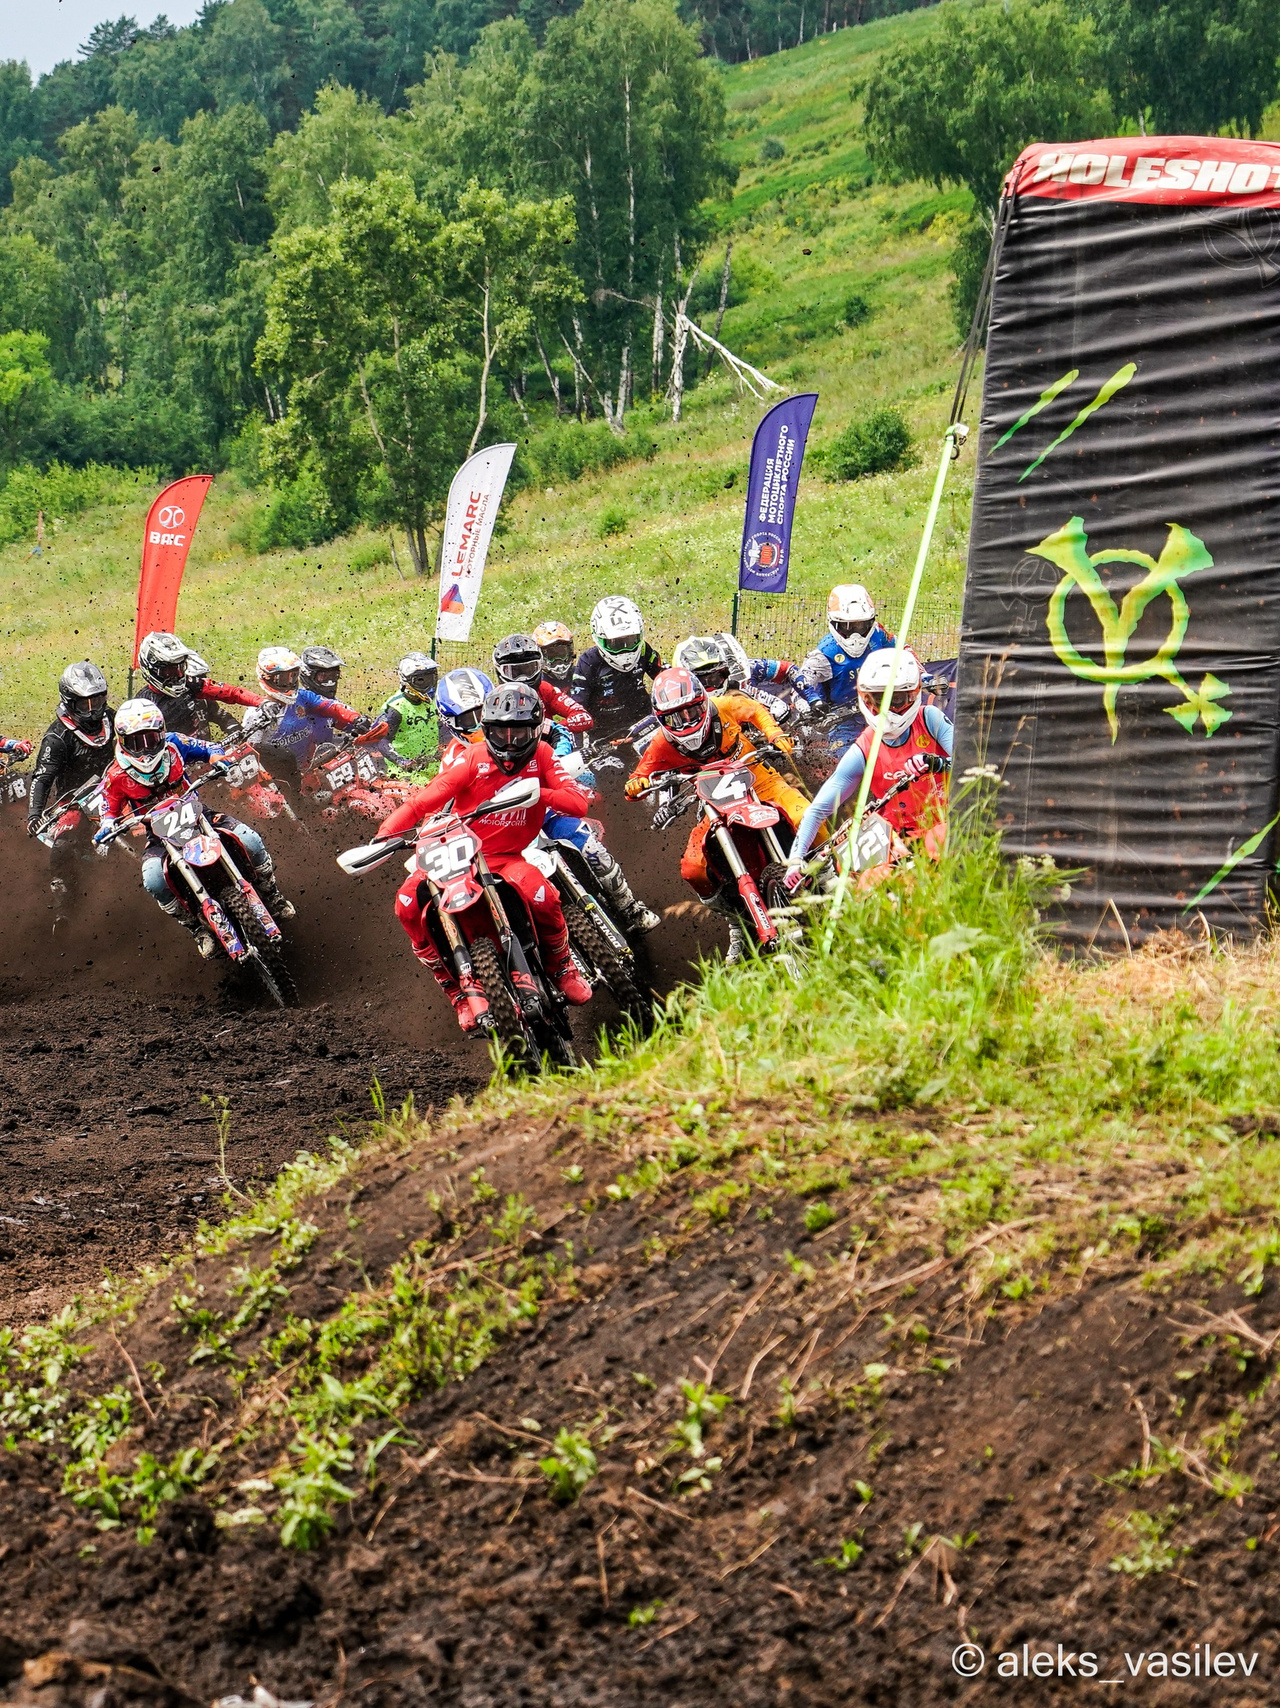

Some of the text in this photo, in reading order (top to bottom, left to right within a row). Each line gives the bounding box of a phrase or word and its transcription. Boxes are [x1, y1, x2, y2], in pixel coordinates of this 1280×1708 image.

[1033, 153, 1280, 194] HOLESHO
[758, 458, 775, 522] ФЕДЕРАЦИЯ
[767, 424, 789, 523] МОТОЦИКЛЕТНОГО
[776, 438, 795, 525] СПОРТА РОССИИ
[475, 493, 490, 527] МАСЛА
[149, 531, 186, 547] BAIC
[451, 490, 482, 577] LEMARC
[325, 762, 355, 790] 159
[711, 772, 747, 800] 4
[163, 802, 197, 838] 24
[478, 818, 527, 828] MOTORSPORTS
[425, 836, 474, 881] 30
